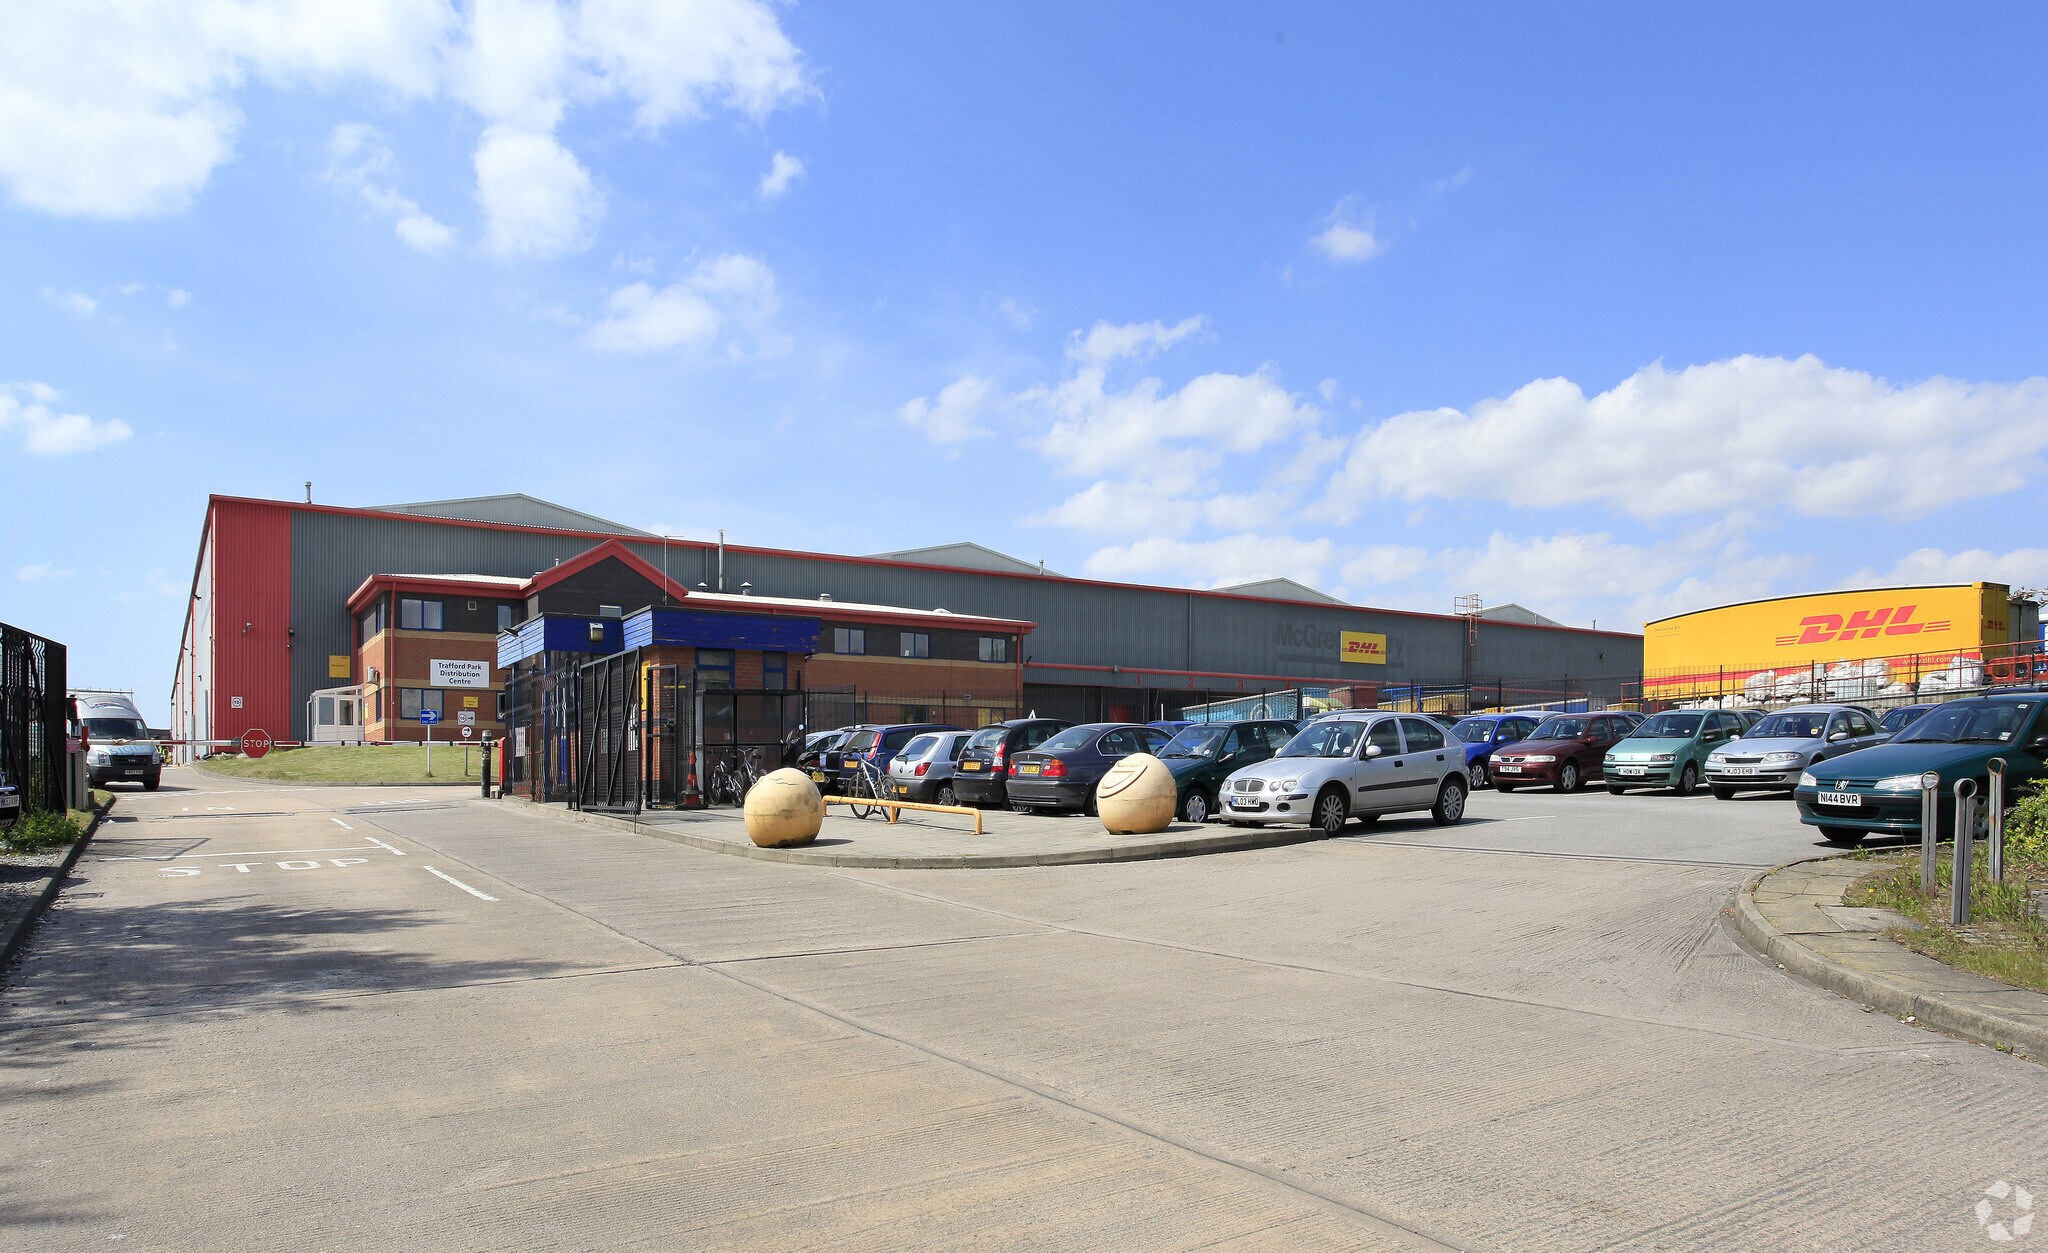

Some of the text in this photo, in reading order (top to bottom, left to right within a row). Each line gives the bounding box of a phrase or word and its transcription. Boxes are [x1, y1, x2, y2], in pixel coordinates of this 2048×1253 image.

[1797, 605, 1925, 645] DHL
[1276, 621, 1341, 655] McGre
[1347, 641, 1380, 654] DHL
[1901, 655, 1951, 666] www.dhl.com
[1136, 673, 1141, 686] 1
[1188, 677, 1194, 689] 2
[1238, 679, 1244, 691] 3
[243, 739, 270, 748] STOP
[1820, 793, 1858, 804] N144 BVR
[158, 857, 370, 877] STOP
